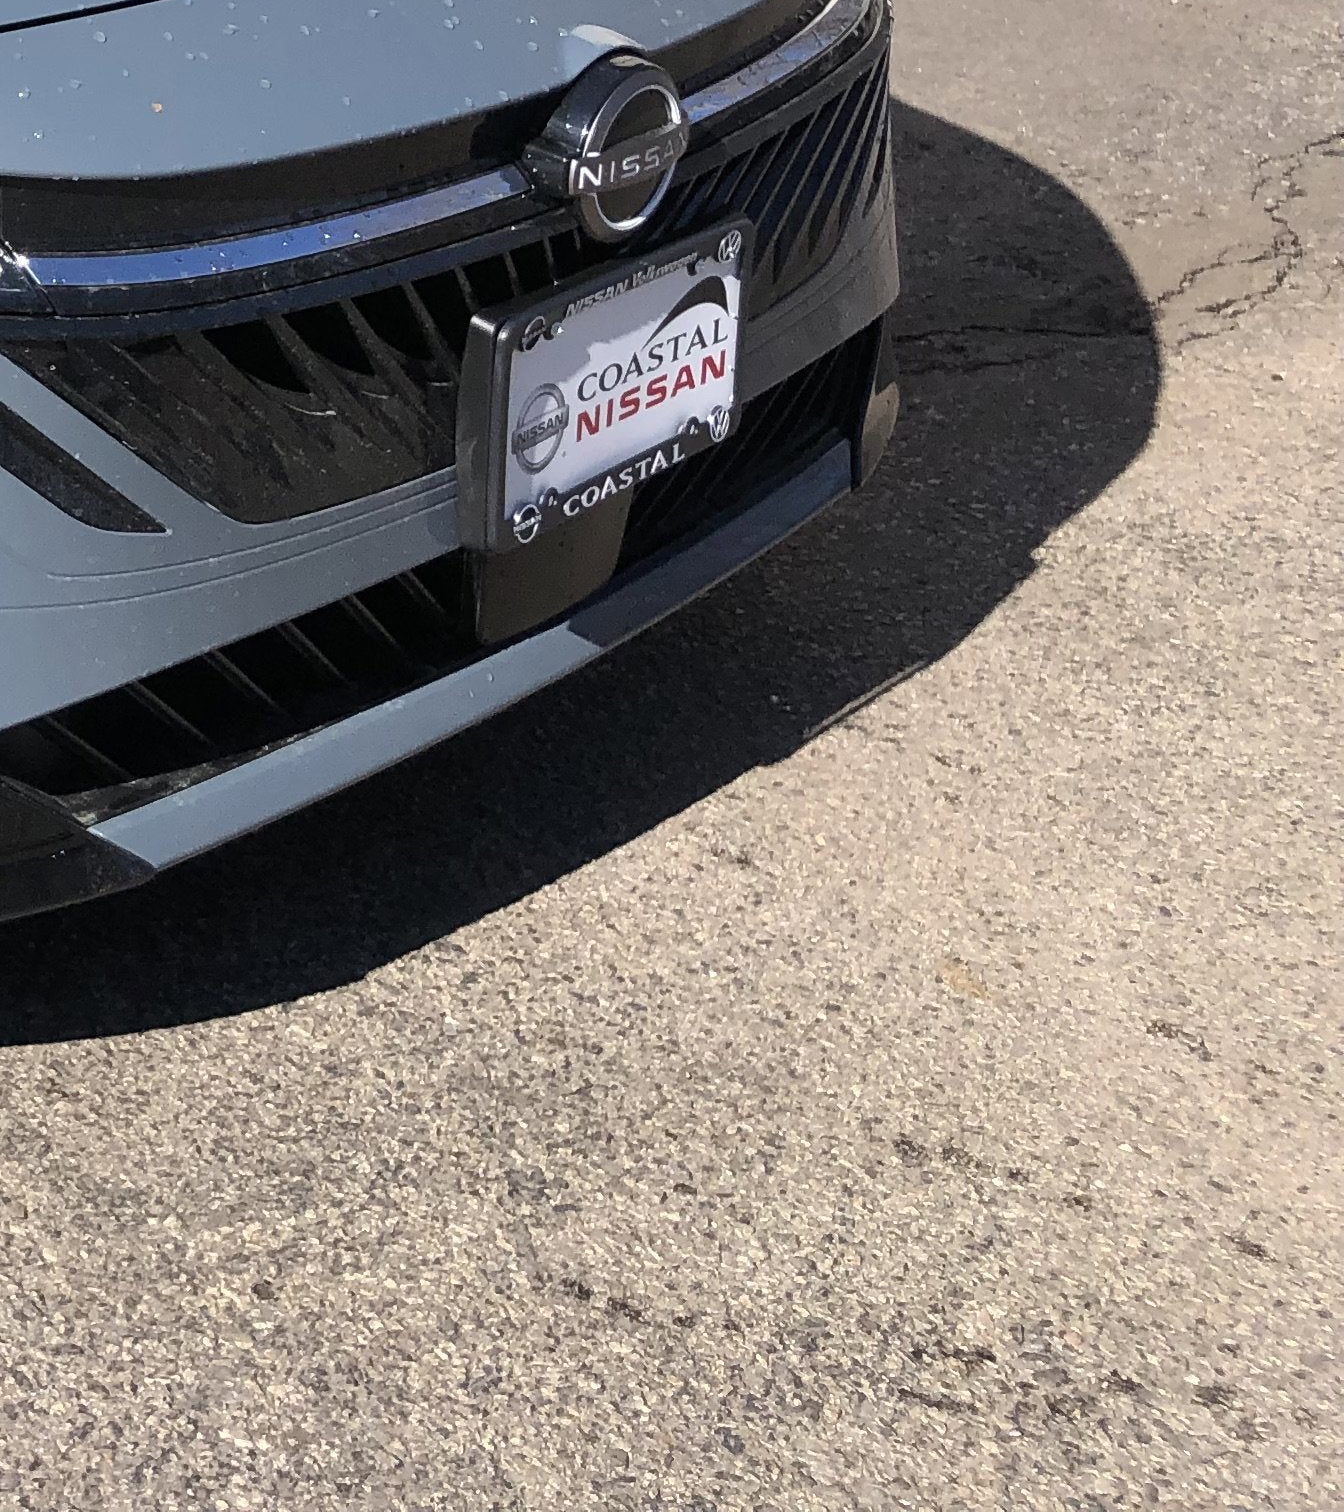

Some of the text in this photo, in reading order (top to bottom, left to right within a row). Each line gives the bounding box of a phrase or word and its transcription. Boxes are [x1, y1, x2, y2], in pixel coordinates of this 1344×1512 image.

[565, 279, 629, 318] NISSAN
[576, 349, 726, 442] NISSAN
[577, 318, 729, 402] COASTAL
[516, 413, 565, 449] NISSAN
[563, 442, 685, 517] COASTAL
